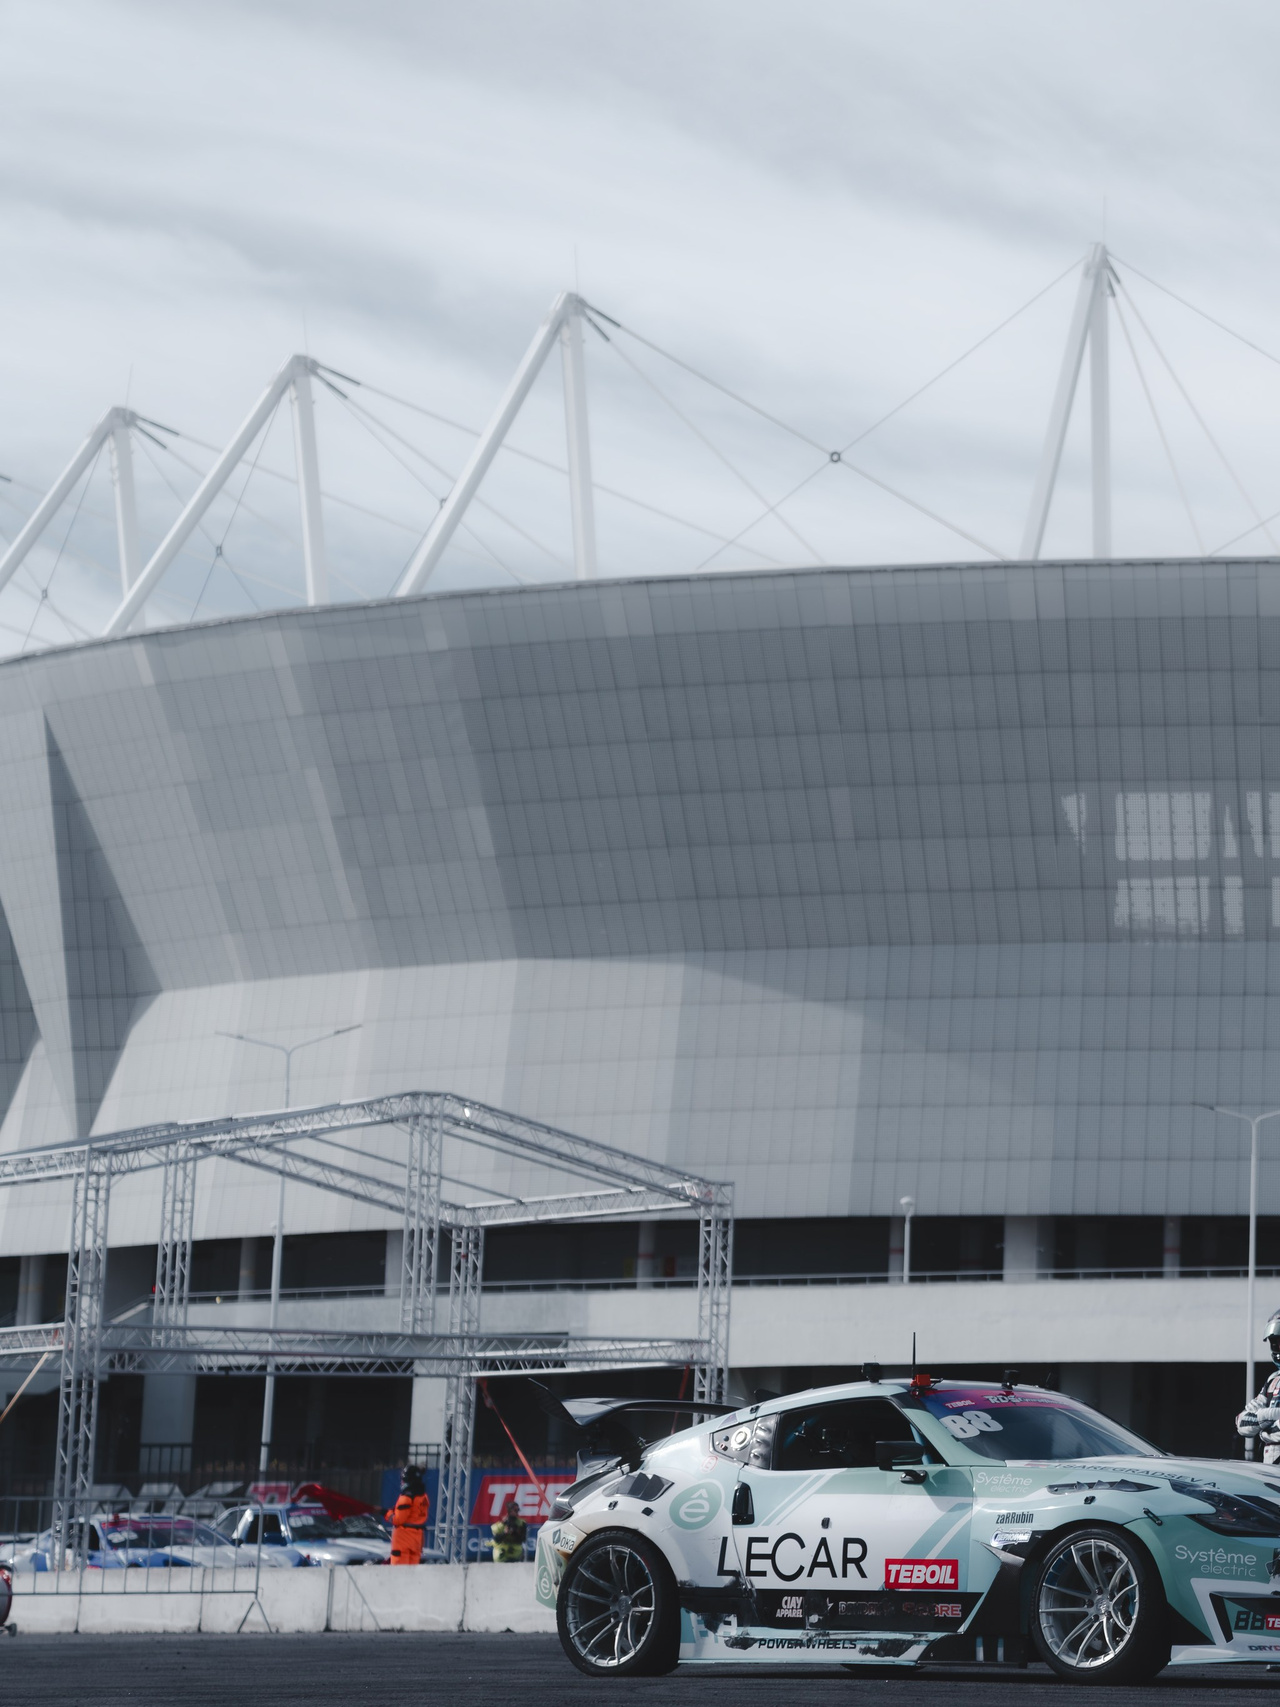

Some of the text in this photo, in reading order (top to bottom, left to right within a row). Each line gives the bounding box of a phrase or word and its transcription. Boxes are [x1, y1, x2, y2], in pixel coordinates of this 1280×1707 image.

[976, 1472, 1033, 1486] Système
[990, 1485, 1030, 1493] electric
[996, 1511, 1035, 1524] zaRRubin
[716, 1532, 869, 1582] LECAR
[1175, 1545, 1257, 1564] Système
[887, 1564, 956, 1585] TEBOIL
[1201, 1562, 1257, 1577] electric
[775, 1608, 804, 1618] APPAREL
